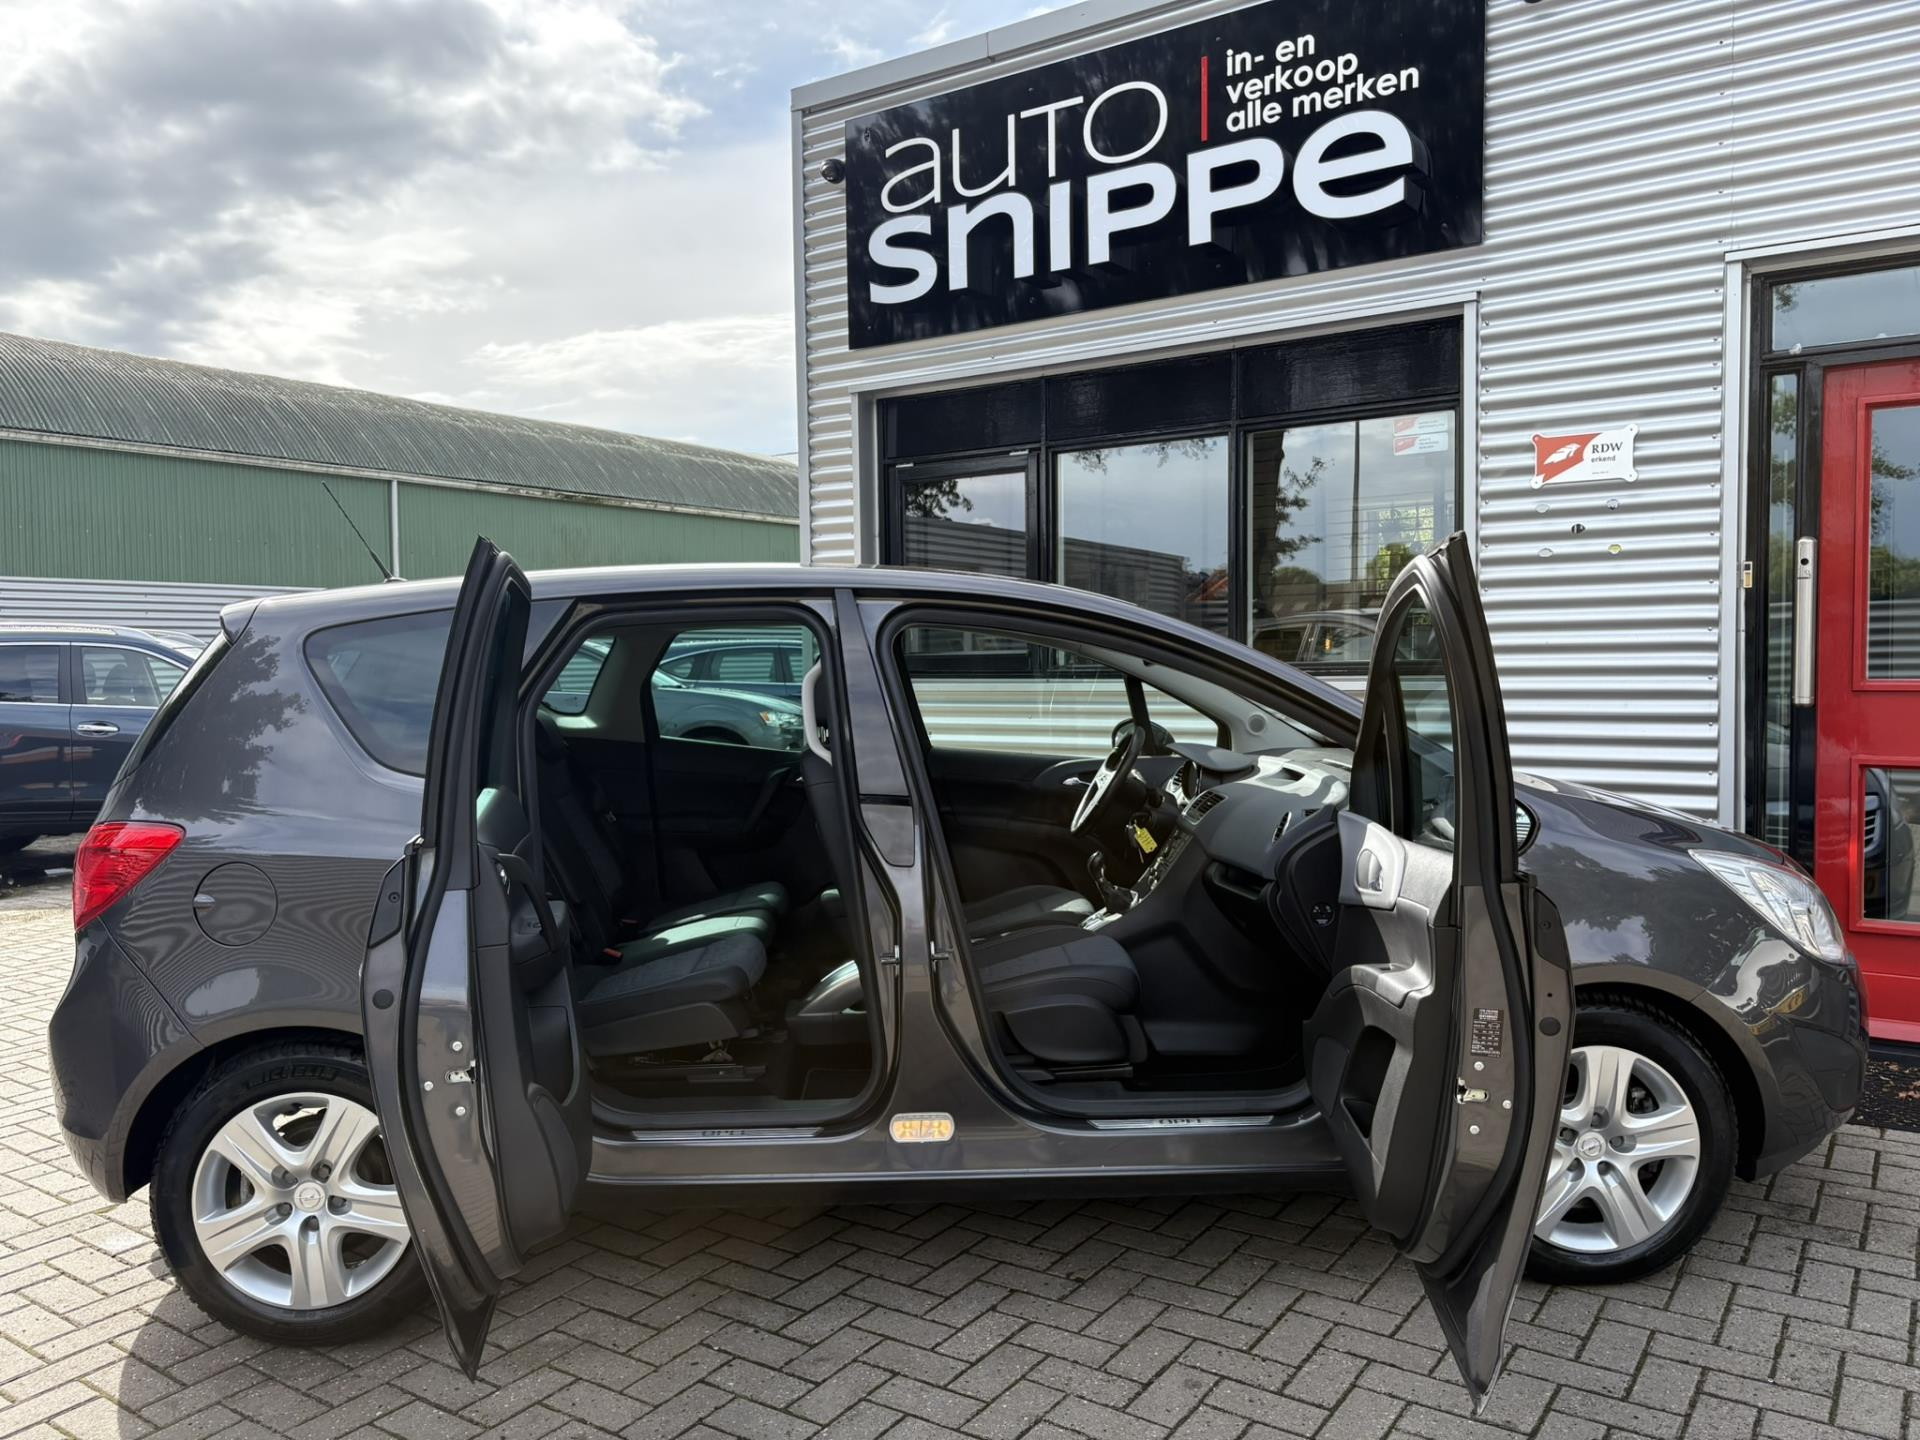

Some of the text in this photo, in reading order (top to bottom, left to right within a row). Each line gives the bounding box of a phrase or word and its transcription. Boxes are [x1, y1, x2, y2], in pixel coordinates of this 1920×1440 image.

[1226, 33, 1316, 77] in- en
[1226, 52, 1359, 104] verkoop
[1226, 66, 1420, 133] alle merken
[1590, 455, 1616, 463] erkend
[1591, 441, 1623, 454] RDW
